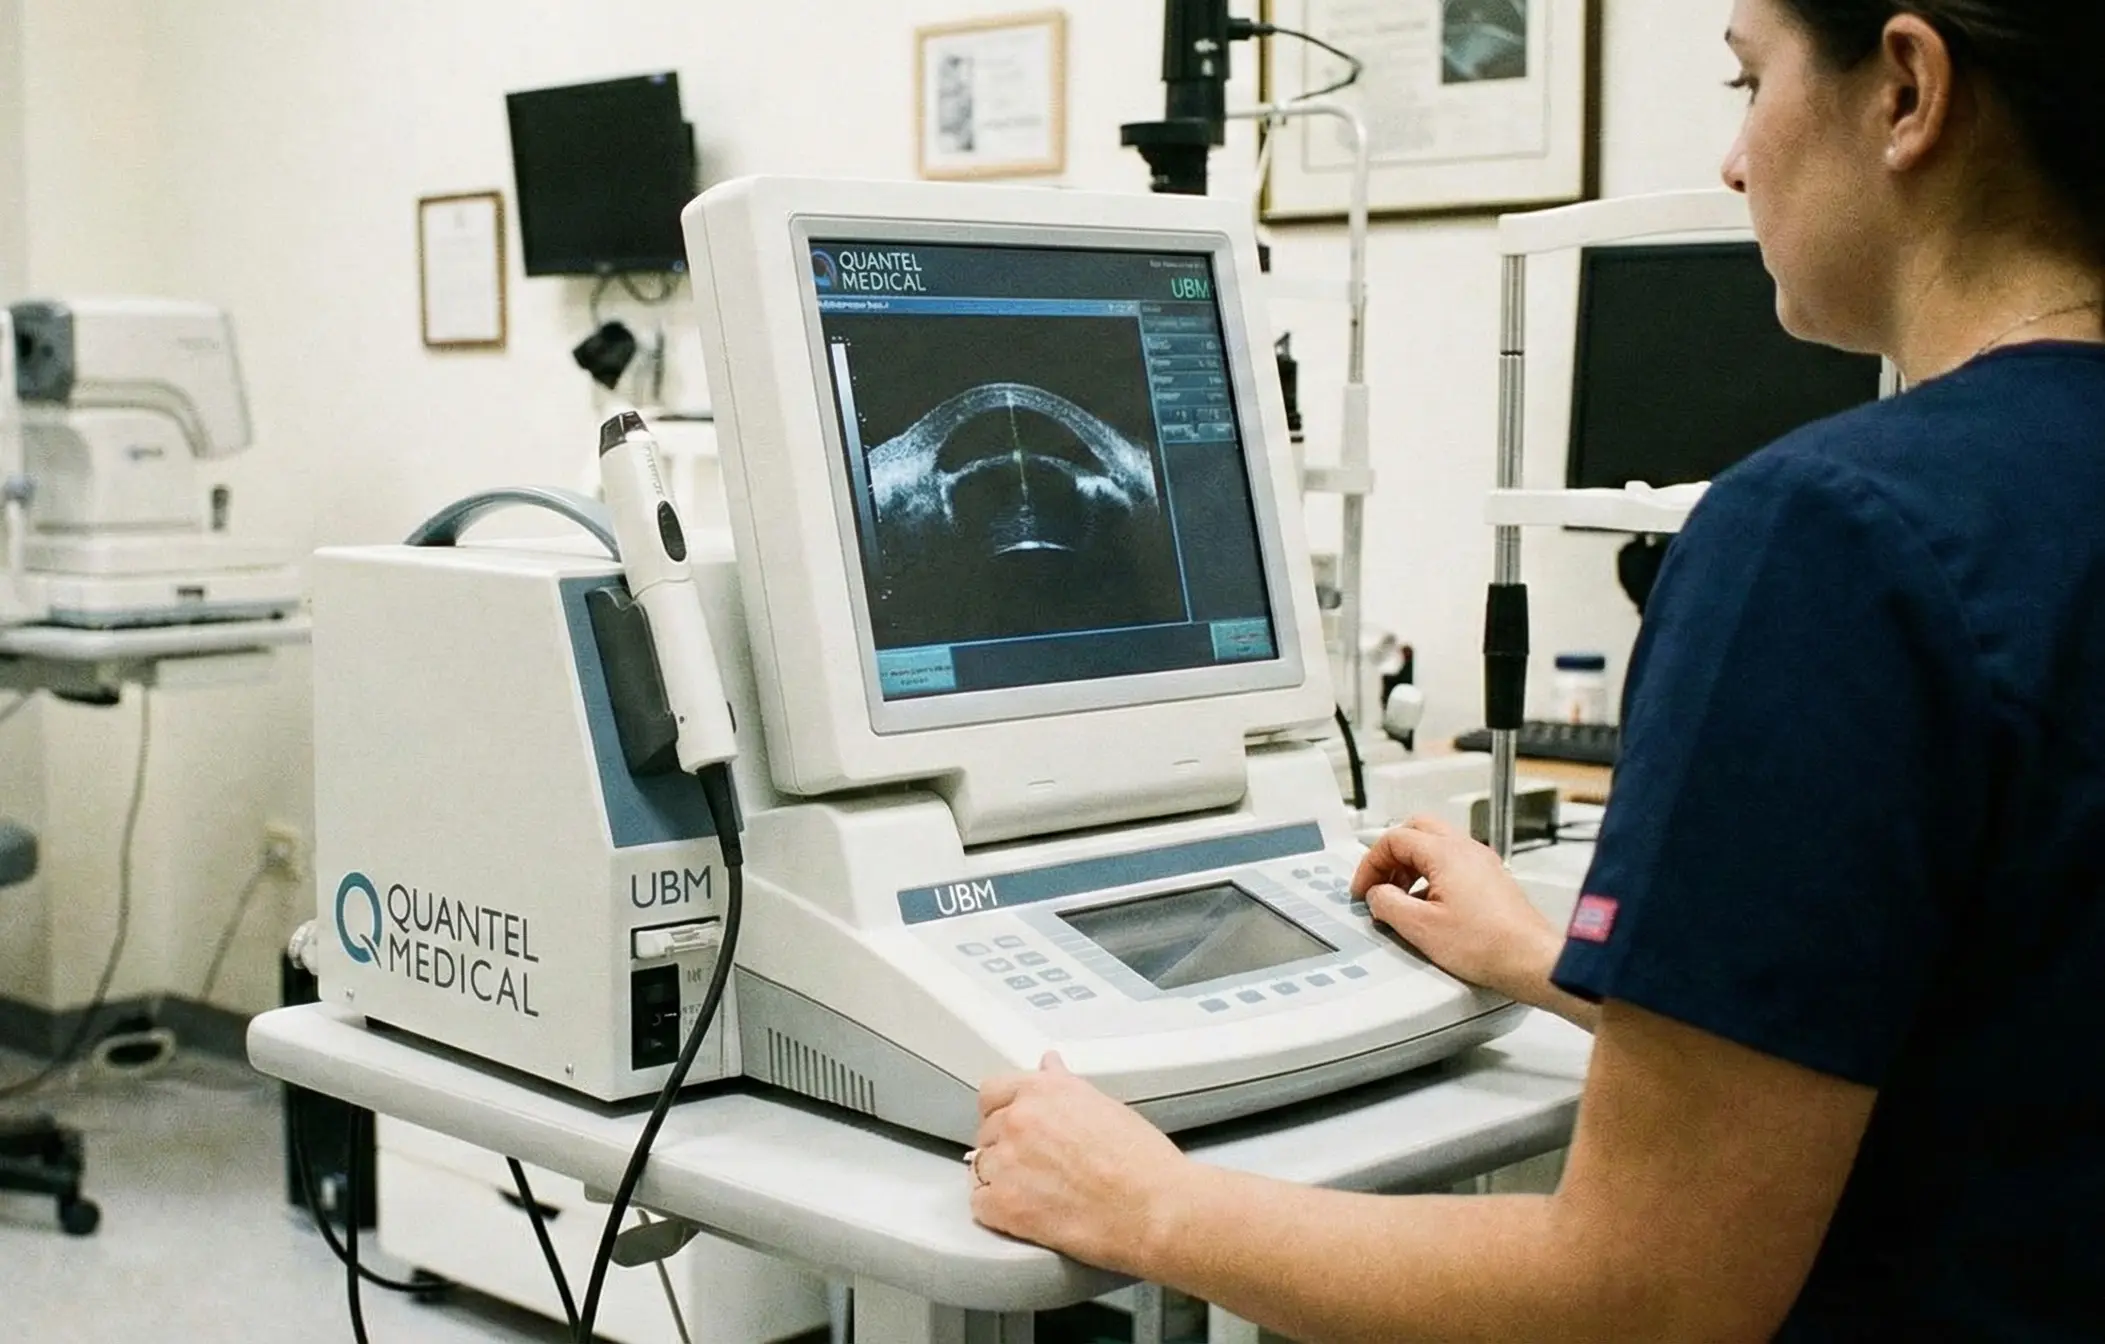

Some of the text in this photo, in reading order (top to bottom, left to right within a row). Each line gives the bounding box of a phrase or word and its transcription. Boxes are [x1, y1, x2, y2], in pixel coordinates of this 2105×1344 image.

[839, 251, 923, 272] QUANTEL
[842, 272, 927, 291] MEDICAL
[1171, 278, 1210, 299] UBM
[631, 865, 712, 909] UBM
[934, 879, 998, 915] UBM
[387, 882, 540, 963] QUANTEL
[389, 933, 540, 1018] MEDICAL
